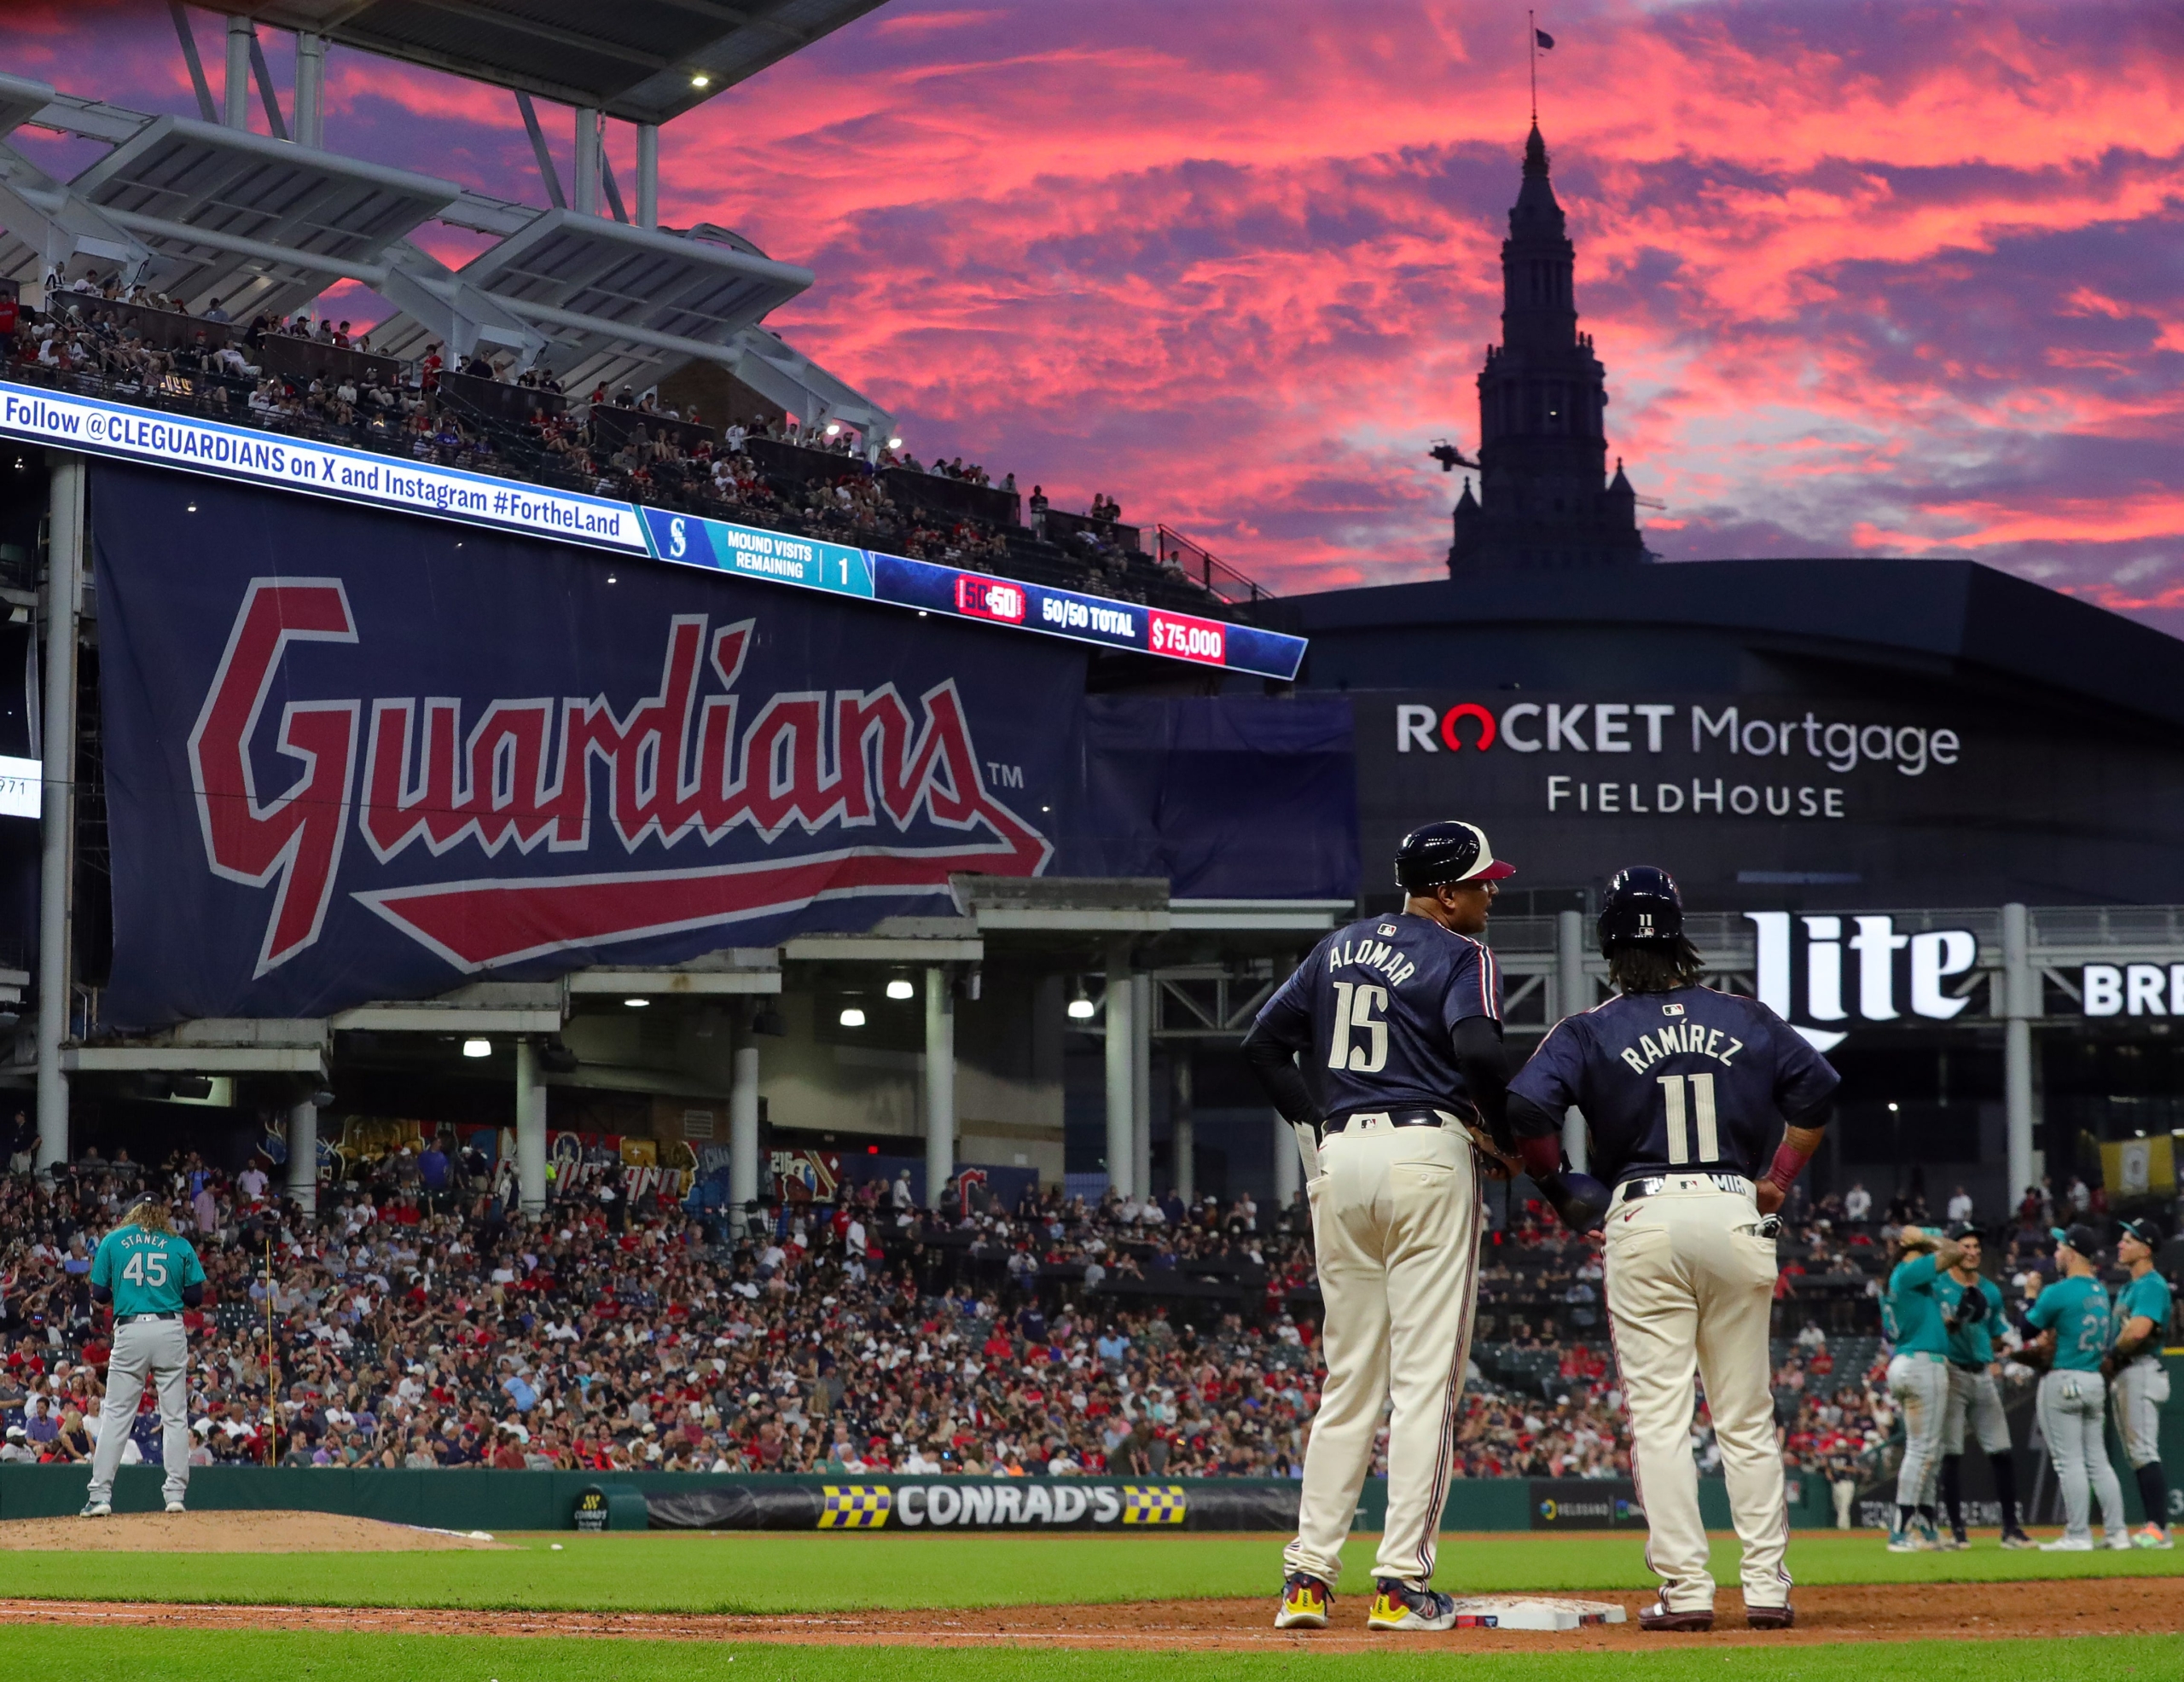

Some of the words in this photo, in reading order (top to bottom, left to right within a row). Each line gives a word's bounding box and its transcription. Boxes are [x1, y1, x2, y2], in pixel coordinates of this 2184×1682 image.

[6, 397, 80, 433] Follow
[86, 413, 285, 473] @CLEGUARDIANS
[291, 457, 316, 478] on
[322, 457, 336, 483] X
[342, 467, 378, 490] and
[386, 473, 487, 511] Instagram
[494, 490, 620, 536] #FortheLand
[728, 531, 773, 552] MOUND
[774, 540, 812, 561] VISITS
[736, 551, 804, 578] REMAINING
[839, 558, 848, 584] 1
[1043, 598, 1088, 628] 50/50
[1090, 607, 1136, 637] TOTAL
[1153, 618, 1222, 658] $75,000
[1397, 703, 1674, 752] ROCKET
[1692, 706, 1960, 775] Mortgage
[187, 577, 1054, 980] Guardians
[986, 762, 1024, 789] TM
[1639, 914, 1652, 926] 11
[1329, 939, 1416, 987] ALOMAR
[1328, 982, 1389, 1072] 15
[1621, 1018, 1744, 1075] RAMÍREZ
[1656, 1073, 1719, 1164] 11
[120, 1233, 169, 1250] STANEK
[123, 1252, 169, 1287] 45
[897, 1485, 1120, 1525] CONRAD'S
